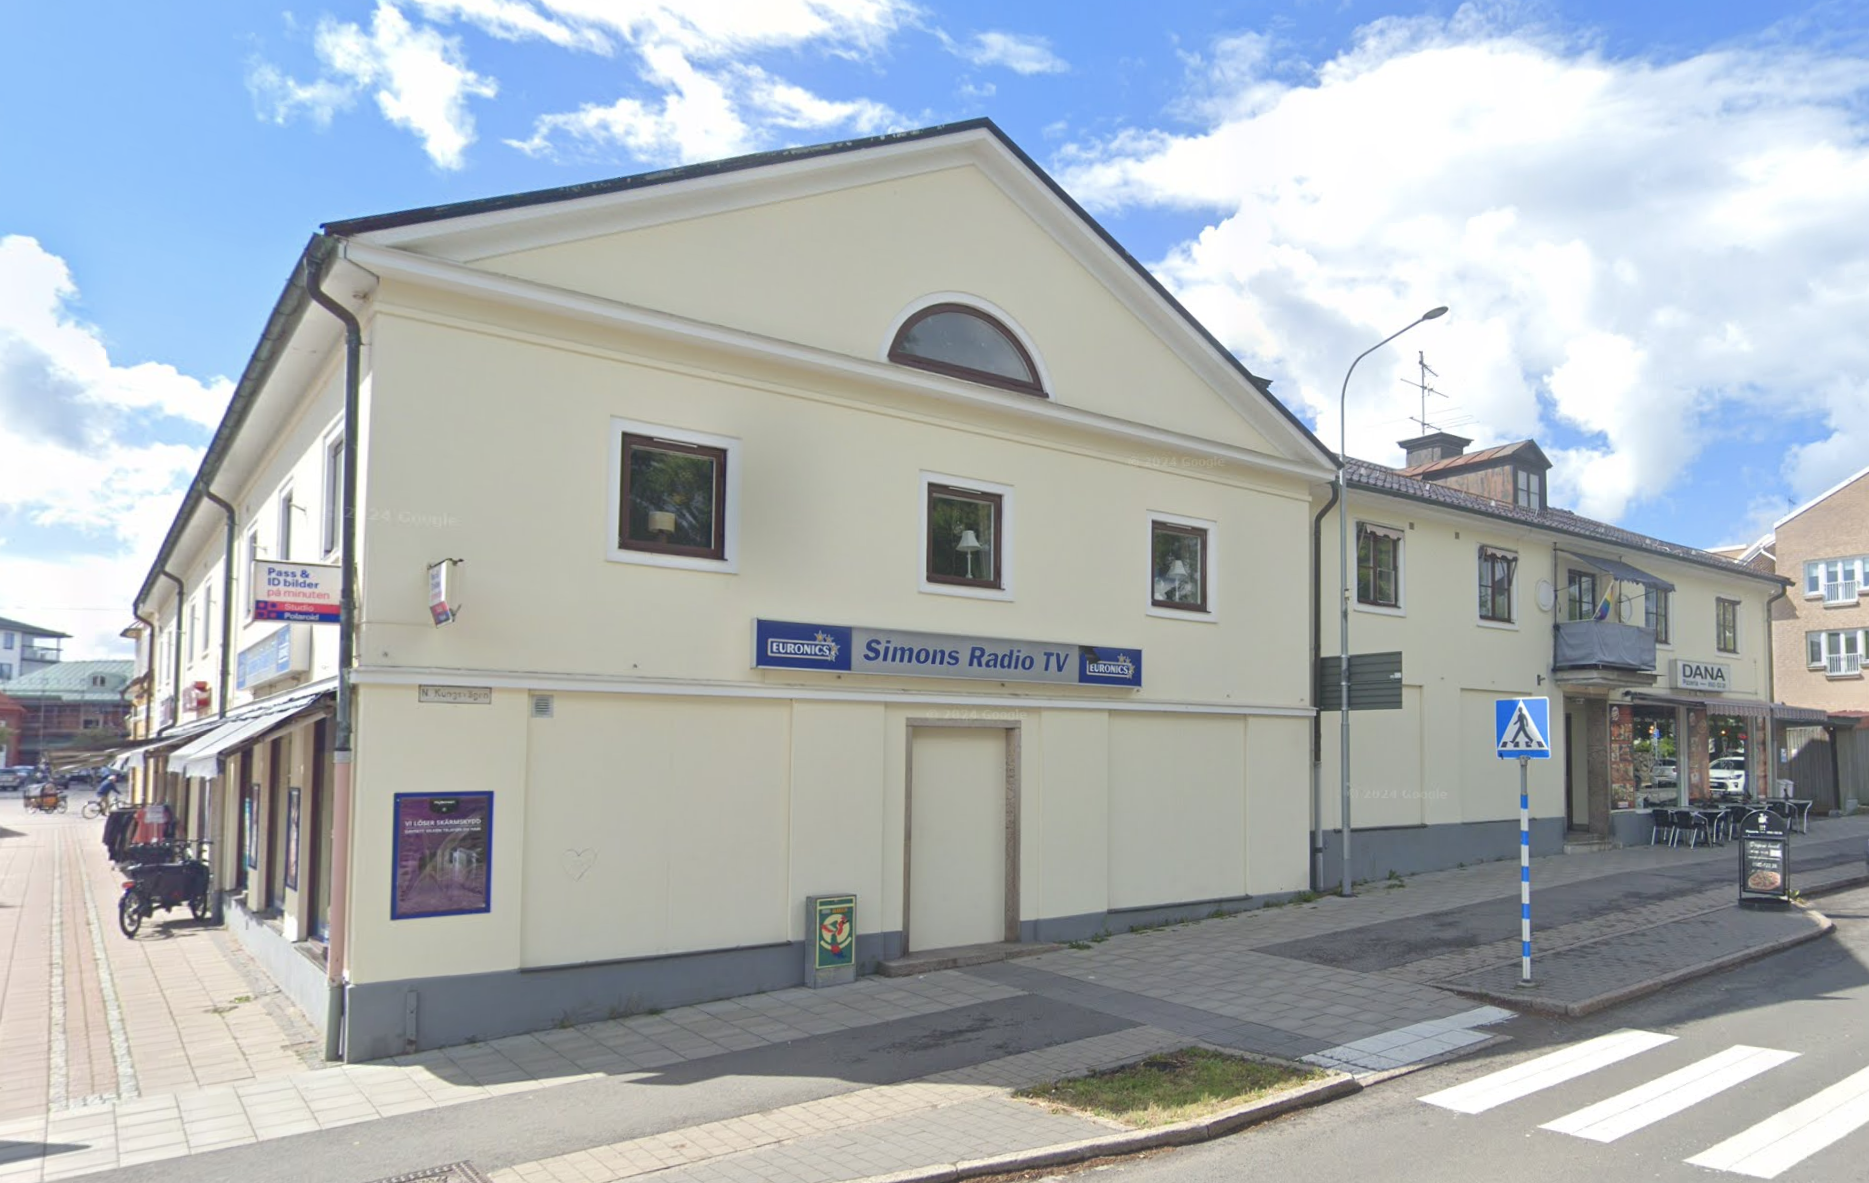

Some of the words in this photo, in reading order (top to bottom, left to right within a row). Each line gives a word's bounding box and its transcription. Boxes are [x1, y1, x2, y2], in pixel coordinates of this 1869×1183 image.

[267, 567, 297, 578] Pass
[300, 569, 310, 578] &
[268, 577, 281, 586] ID
[283, 579, 319, 589] bilder
[267, 588, 282, 598] på
[284, 590, 330, 599] minuten
[284, 603, 314, 611] Studio
[284, 612, 320, 620] Polaroid
[772, 642, 830, 656] EURONICS
[863, 639, 960, 666] Simons
[968, 646, 1035, 671] Radio
[1043, 652, 1069, 672] TV
[1089, 663, 1128, 674] EURONICS
[1682, 663, 1726, 681] DANA
